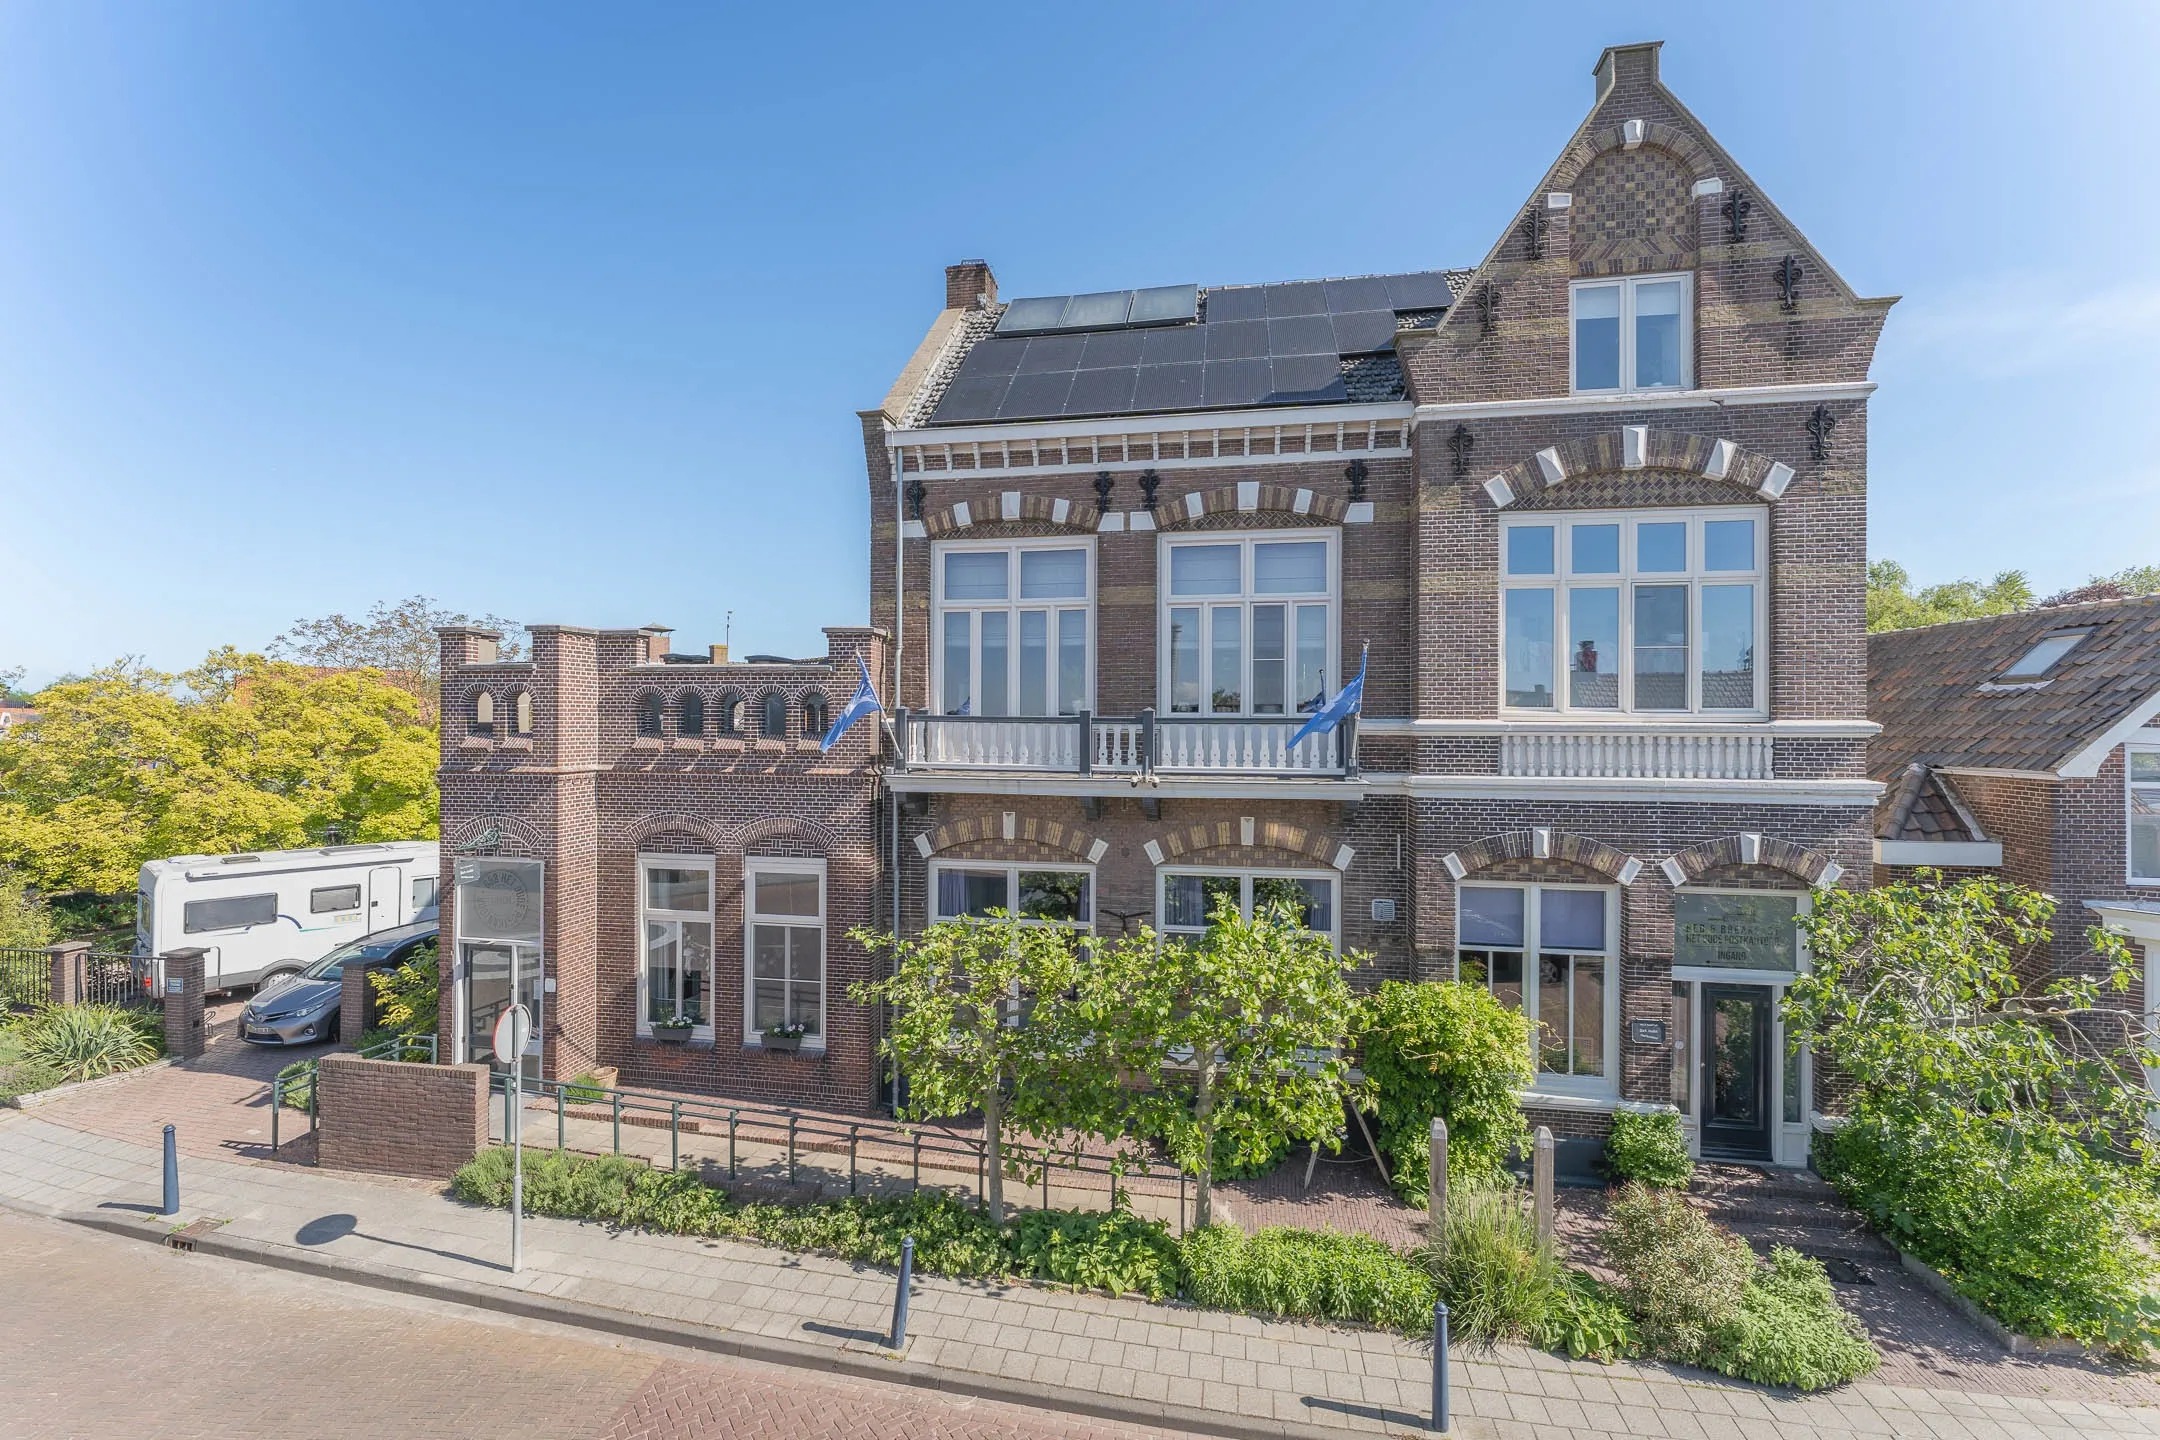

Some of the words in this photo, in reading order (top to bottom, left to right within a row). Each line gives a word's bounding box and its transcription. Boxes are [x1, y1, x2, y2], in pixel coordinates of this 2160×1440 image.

[1720, 925, 1780, 936] BREAKST
[1686, 934, 1701, 944] HET
[1718, 951, 1747, 961] INGANG
